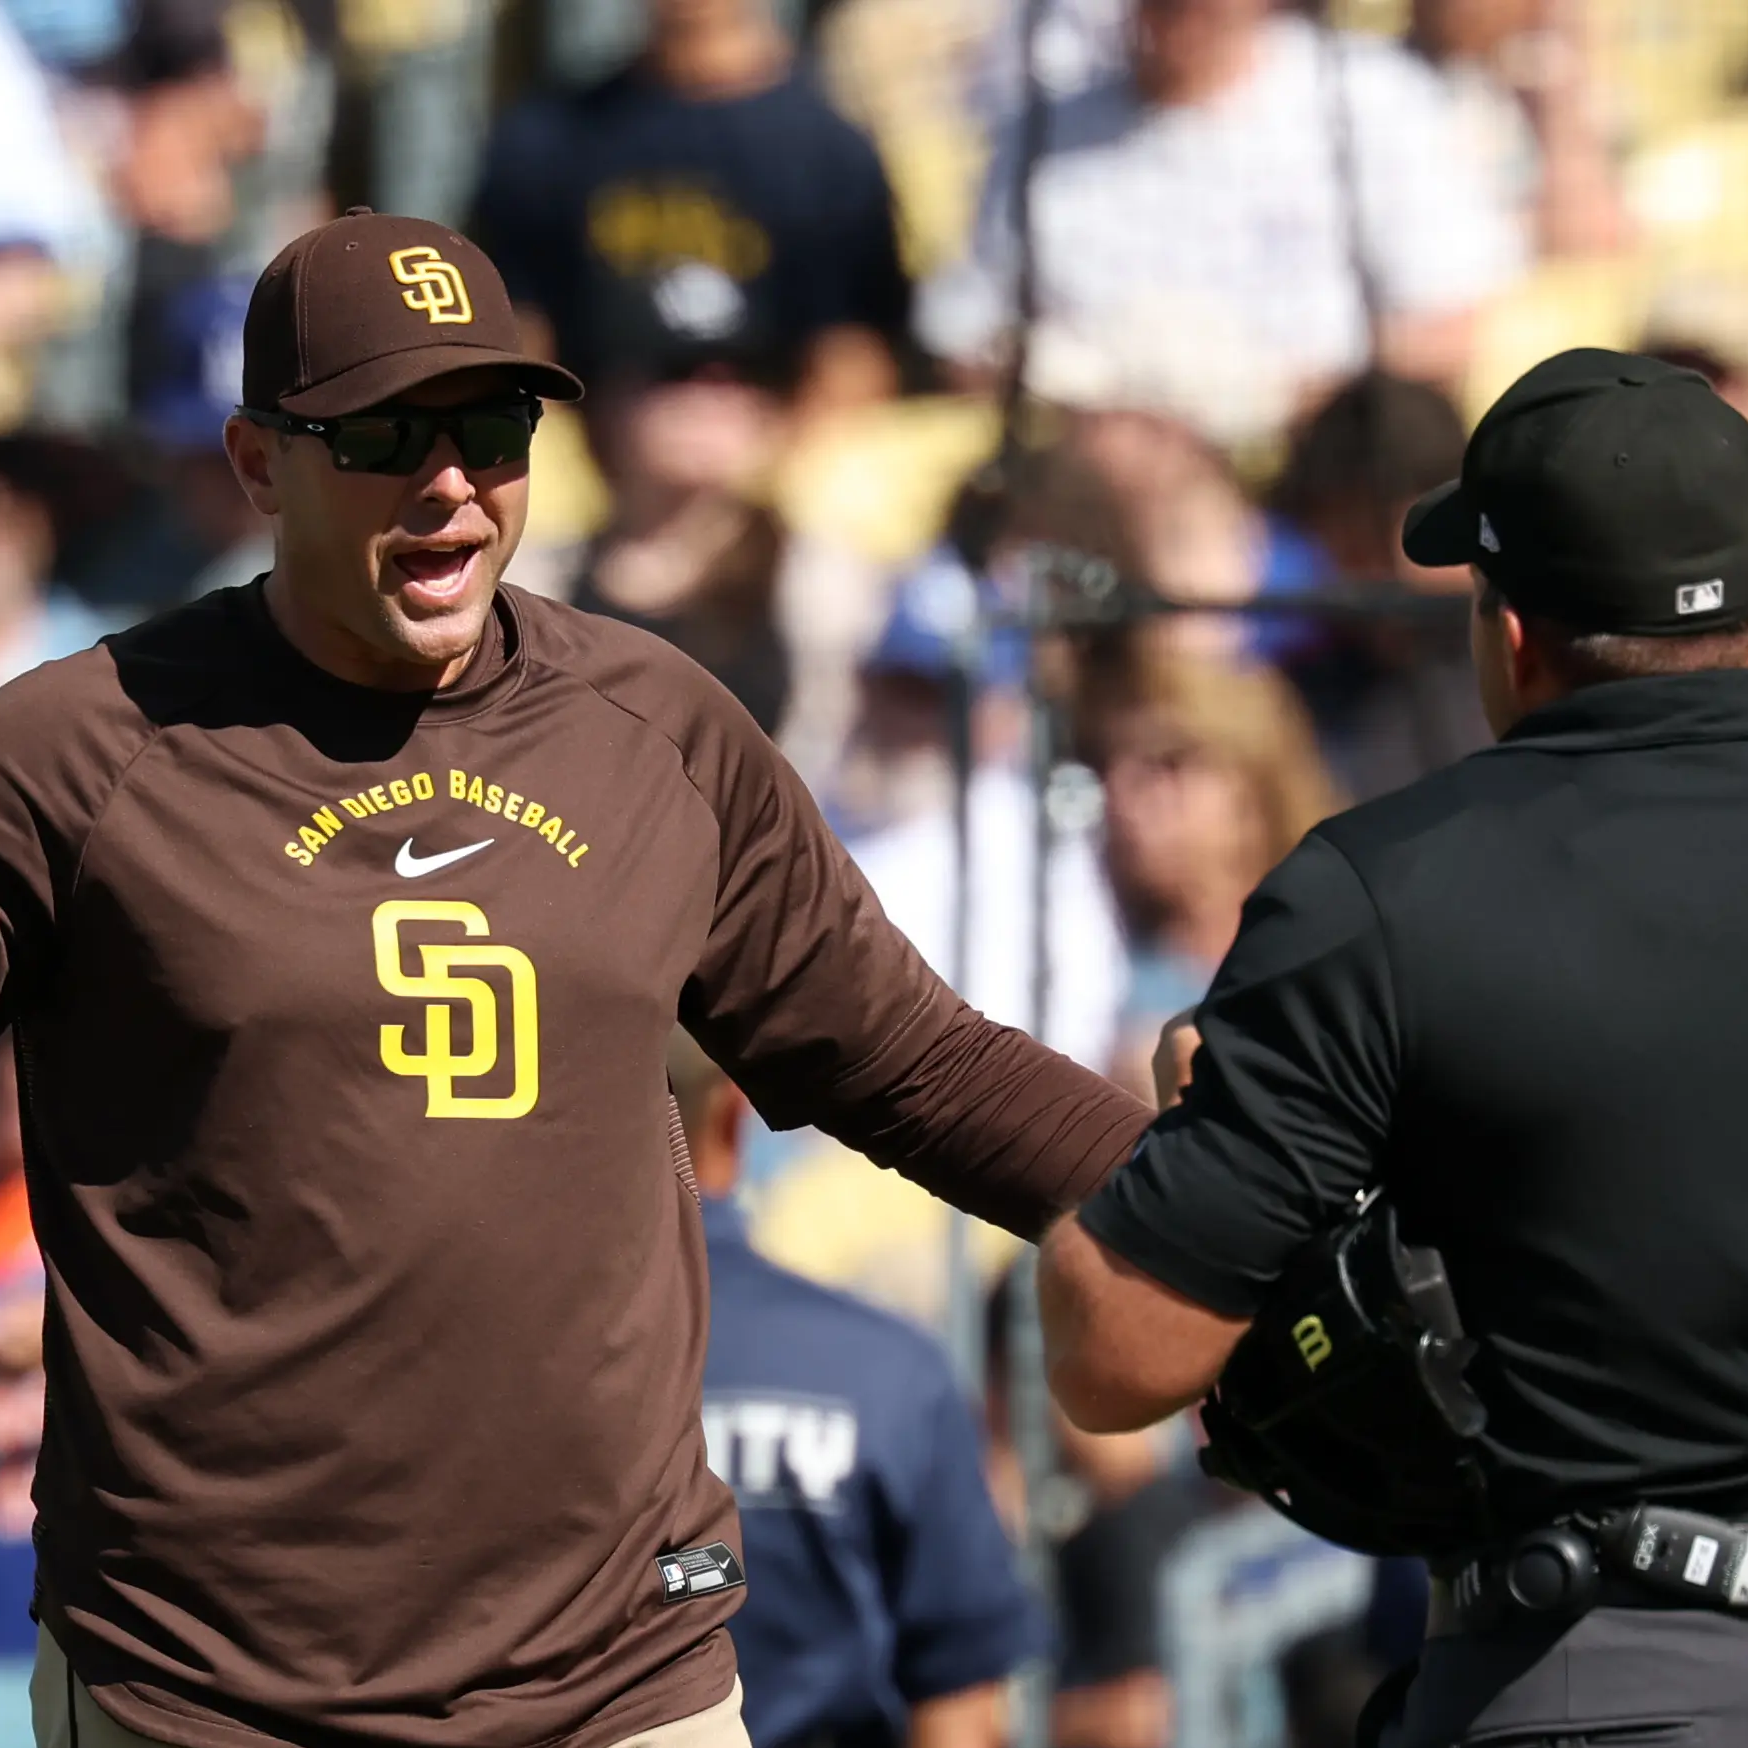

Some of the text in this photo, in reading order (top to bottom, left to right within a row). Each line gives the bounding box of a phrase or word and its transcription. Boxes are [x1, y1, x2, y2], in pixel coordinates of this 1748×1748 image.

[388, 246, 474, 325] SD
[285, 769, 592, 869] SAN DIEGO BASEBALL
[372, 900, 540, 1119] SD
[701, 1402, 858, 1500] ITY
